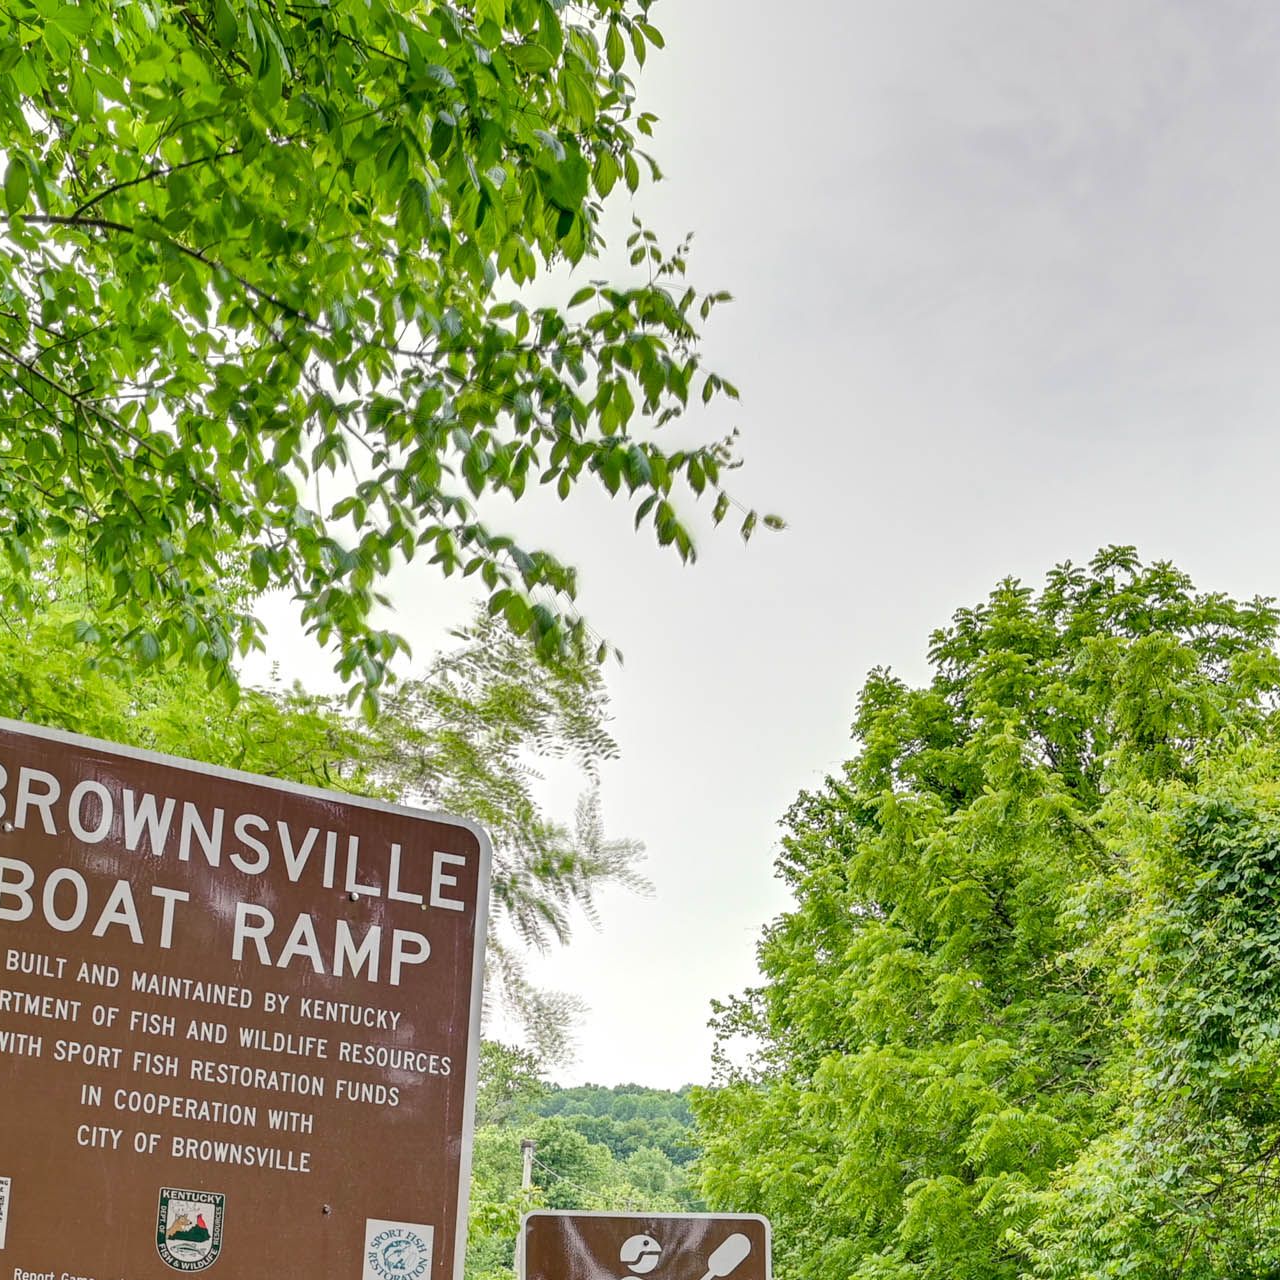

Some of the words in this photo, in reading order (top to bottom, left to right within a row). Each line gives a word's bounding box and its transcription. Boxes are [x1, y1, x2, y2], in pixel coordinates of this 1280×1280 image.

[232, 902, 431, 986] RAMP
[6, 949, 67, 979] BUILT
[76, 962, 120, 988] AND
[131, 970, 252, 1009] MAINTAINED
[264, 992, 290, 1015] BY
[300, 998, 401, 1031] KENTUCKY
[92, 1005, 119, 1028] OF
[129, 1011, 176, 1037] FISH
[186, 1020, 228, 1044] AND
[239, 1027, 328, 1059] WILDLIFE
[339, 1041, 452, 1076] RESOURCES
[53, 1040, 122, 1069] SPORT
[132, 1052, 179, 1077] FISH
[190, 1059, 325, 1097] RESTORATION
[335, 1079, 400, 1107] FUNDS
[80, 1084, 102, 1107] IN
[114, 1089, 257, 1127] COOPERATION
[268, 1109, 313, 1134] WITH
[77, 1125, 123, 1150] CITY
[134, 1132, 161, 1154] OF
[172, 1137, 311, 1173] BROWNSVILLE
[162, 1189, 222, 1204] KENTUCKY
[159, 1225, 166, 1233] OF
[213, 1206, 222, 1245] RESOURCES
[371, 1229, 404, 1249] SPORT
[406, 1231, 428, 1253] FISH
[158, 1243, 175, 1262] FISH
[181, 1247, 218, 1270] WILDLIFE
